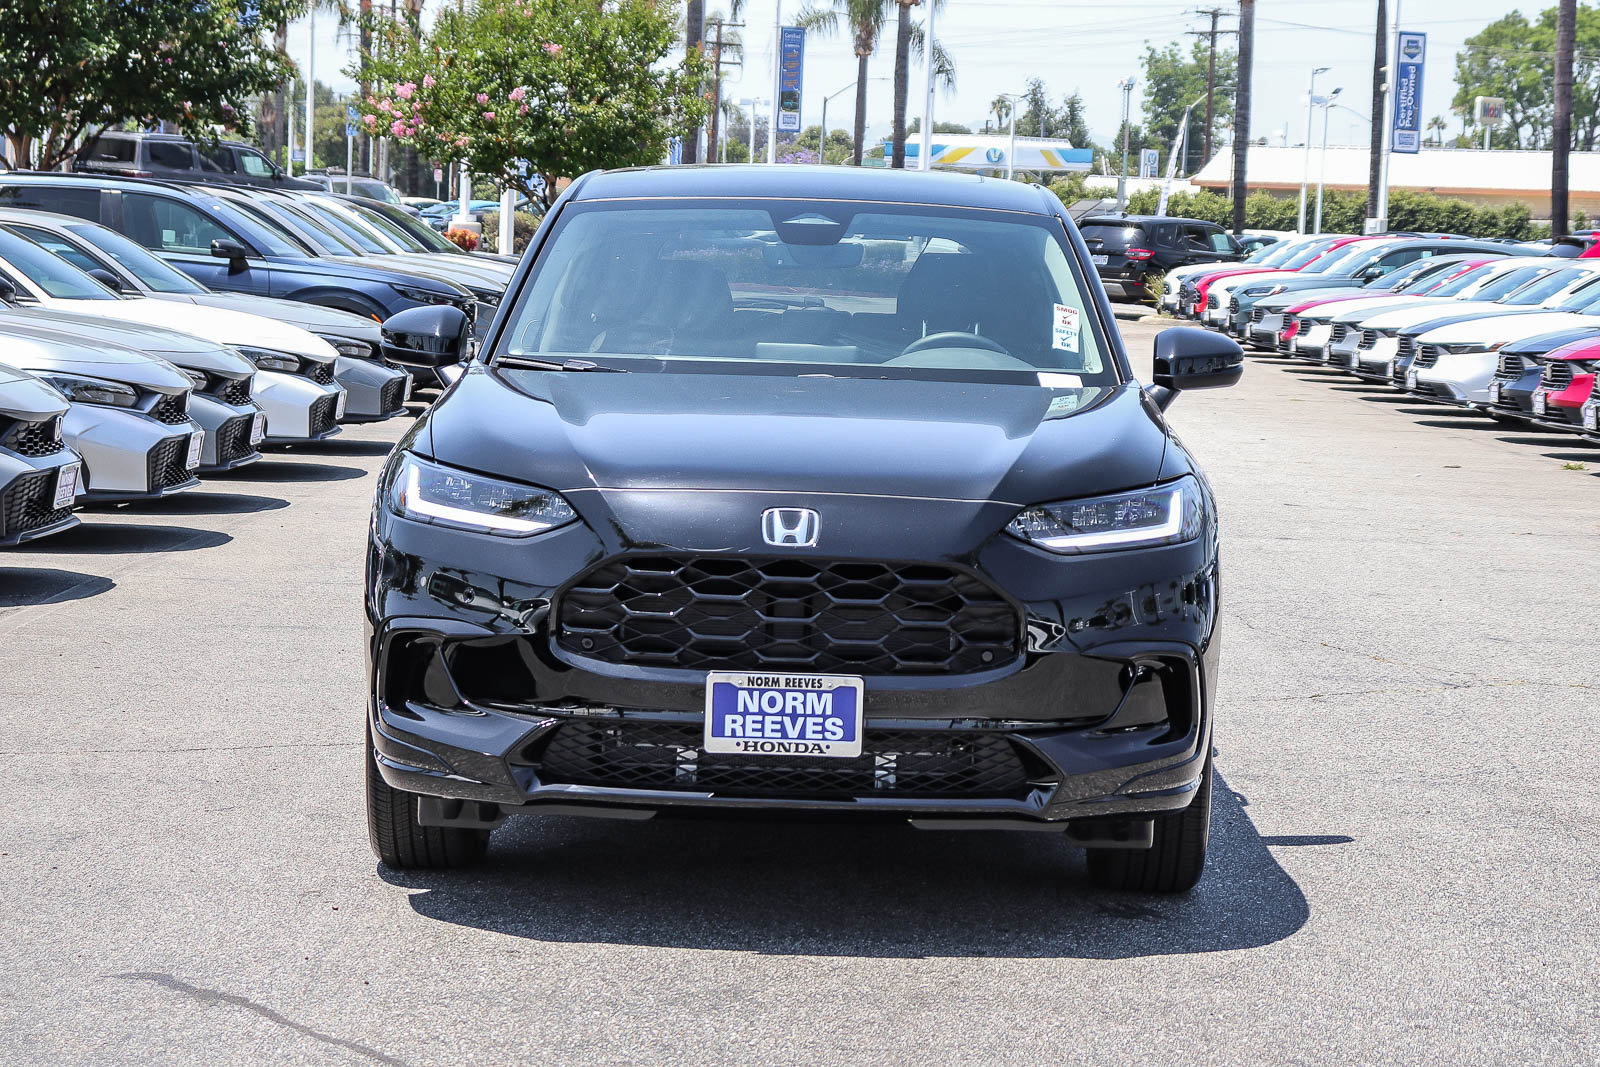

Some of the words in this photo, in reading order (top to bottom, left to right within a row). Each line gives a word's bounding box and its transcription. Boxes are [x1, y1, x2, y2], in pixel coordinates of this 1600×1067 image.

[1398, 78, 1409, 127] Certified
[1405, 65, 1417, 127] Pre-Owned
[1056, 306, 1078, 315] SMOG
[1055, 327, 1077, 336] SAFETY
[1061, 341, 1072, 349] OK
[747, 676, 781, 688] NORM
[784, 677, 823, 689] REEVES
[738, 690, 833, 715] NORM
[724, 715, 844, 741] REEVES
[742, 741, 826, 754] HONDA
